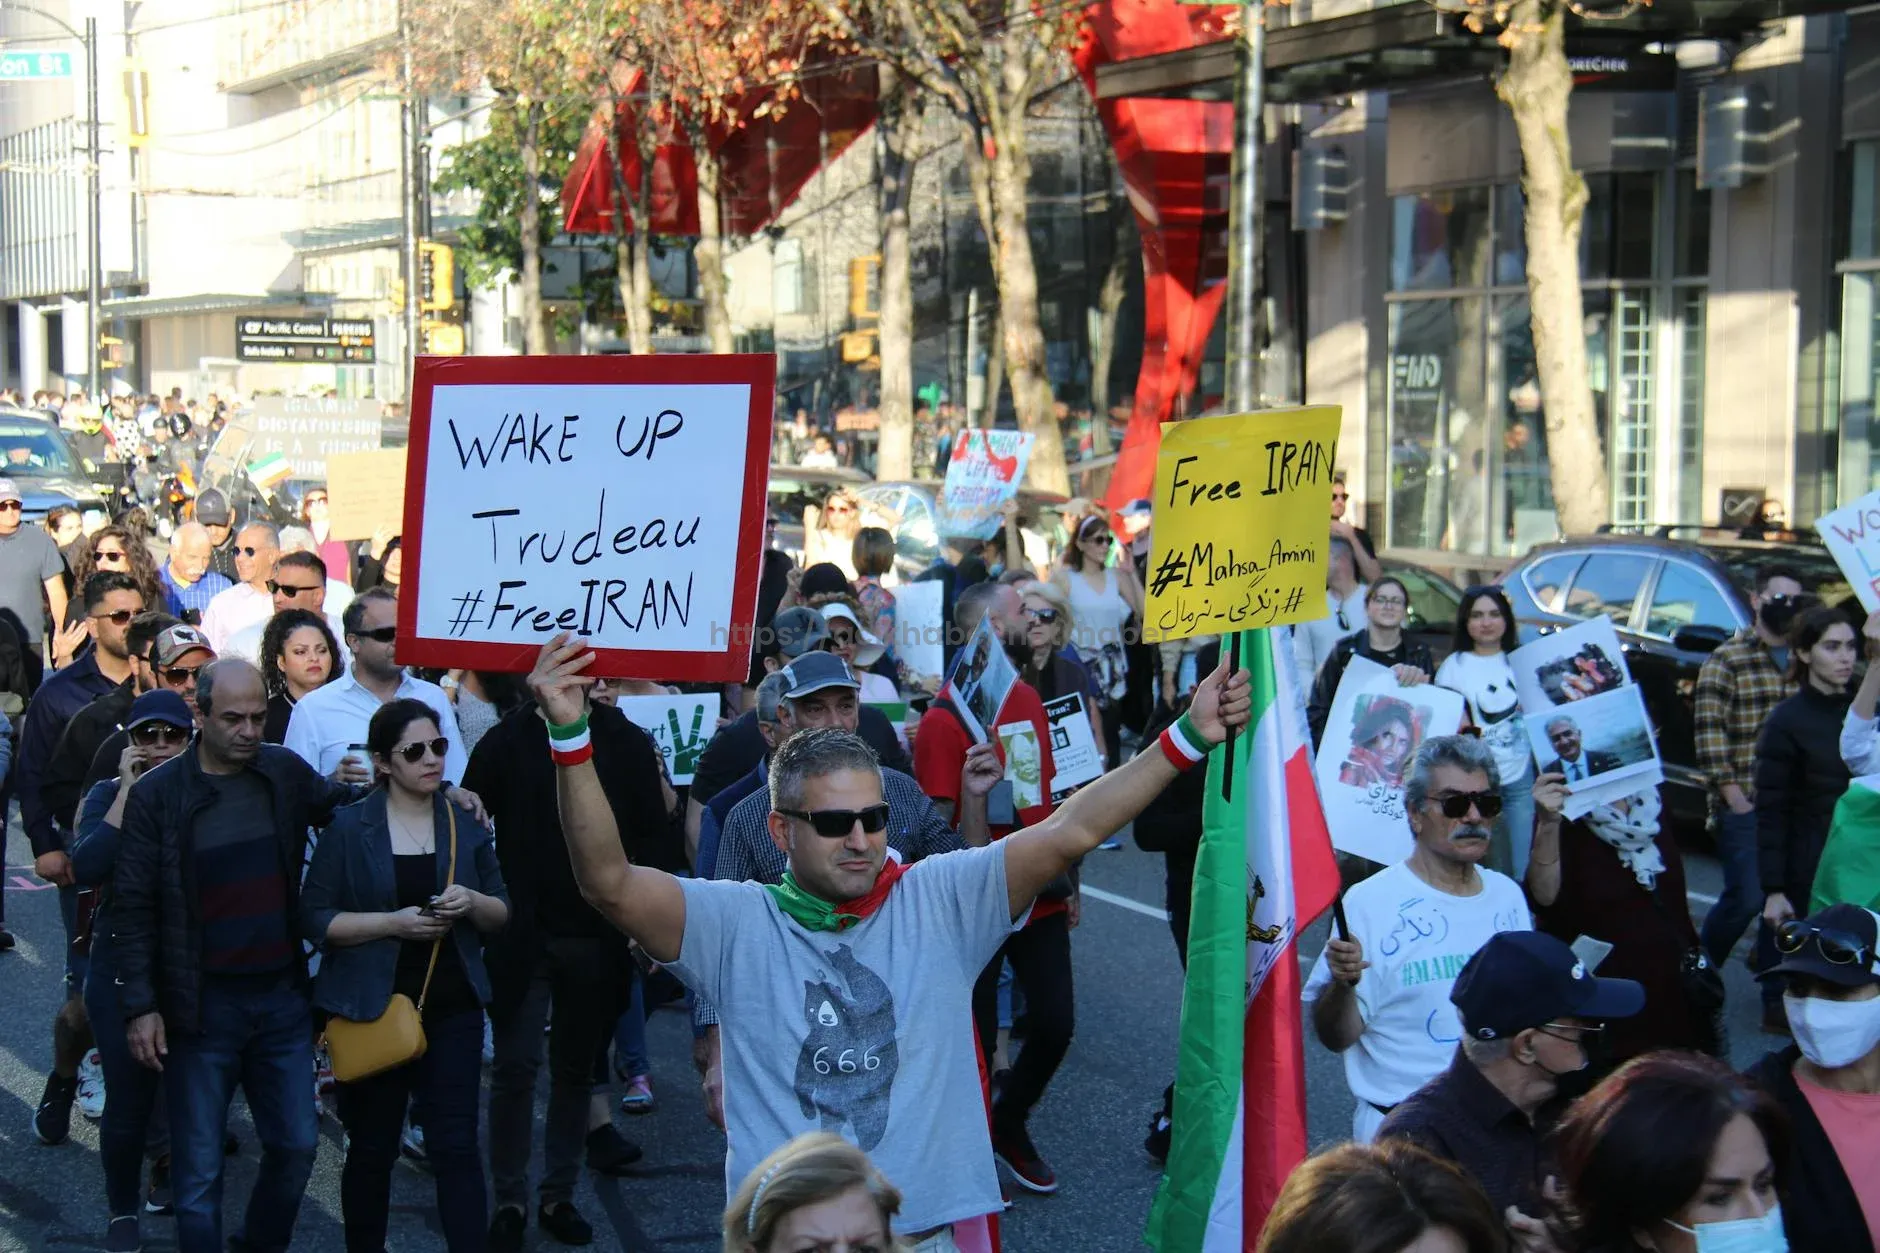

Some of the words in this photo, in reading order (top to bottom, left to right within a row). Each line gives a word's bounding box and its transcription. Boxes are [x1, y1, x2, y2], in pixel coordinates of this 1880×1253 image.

[449, 412, 579, 470] WAKE
[616, 408, 684, 460] UP
[1169, 456, 1242, 508] Free
[1260, 439, 1336, 497] IRAN
[472, 487, 701, 565] Trudeau
[449, 571, 694, 637] #FreeIRAN
[1402, 953, 1474, 987] #MAHS
[812, 1043, 881, 1075] 666
